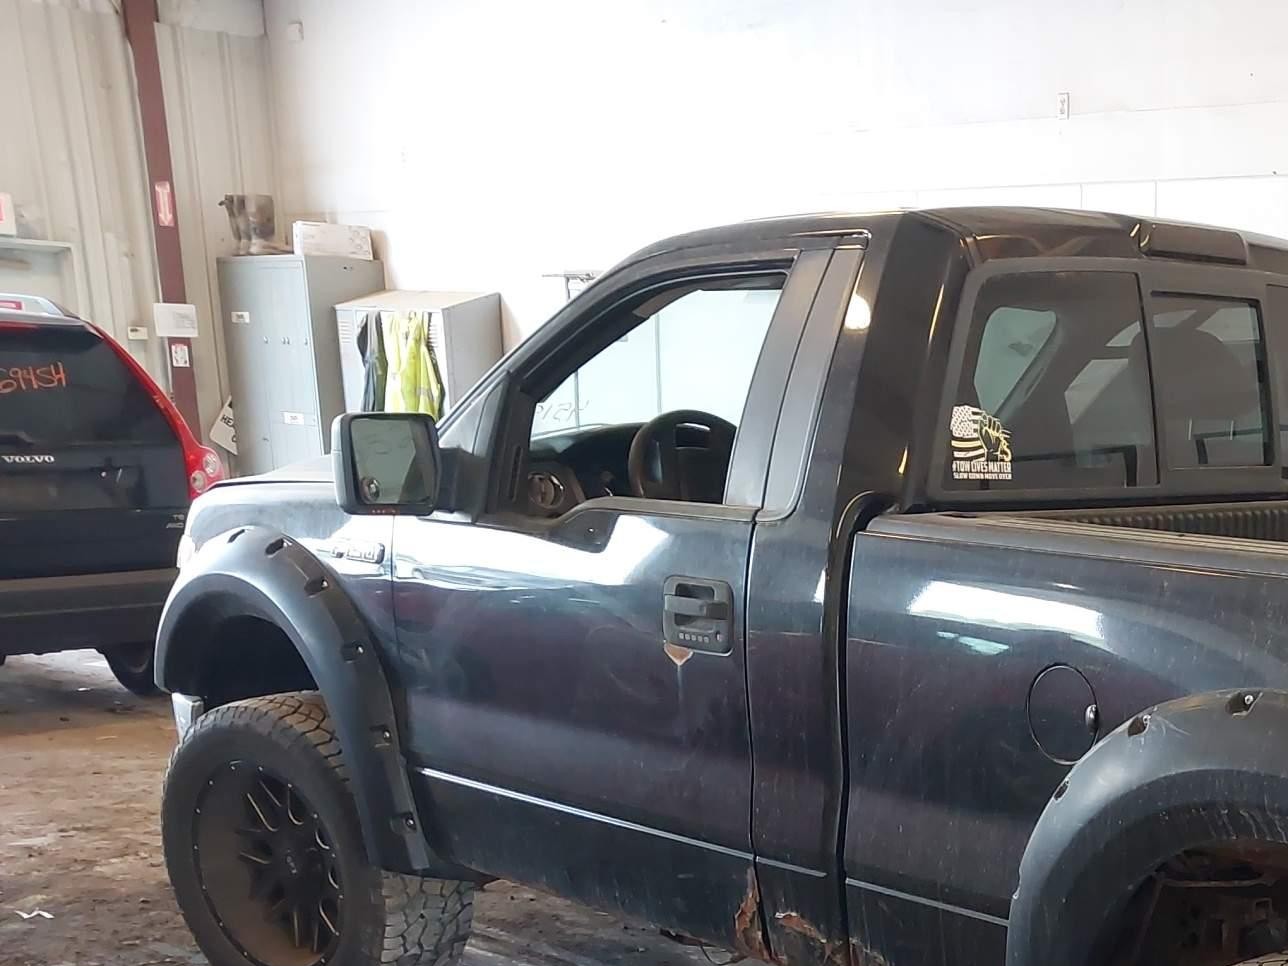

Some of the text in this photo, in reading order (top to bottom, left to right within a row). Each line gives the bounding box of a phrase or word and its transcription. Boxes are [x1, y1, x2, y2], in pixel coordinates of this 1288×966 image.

[1, 455, 55, 464] VOLVO
[971, 462, 988, 472] LIVES
[988, 462, 1012, 473] MATTER
